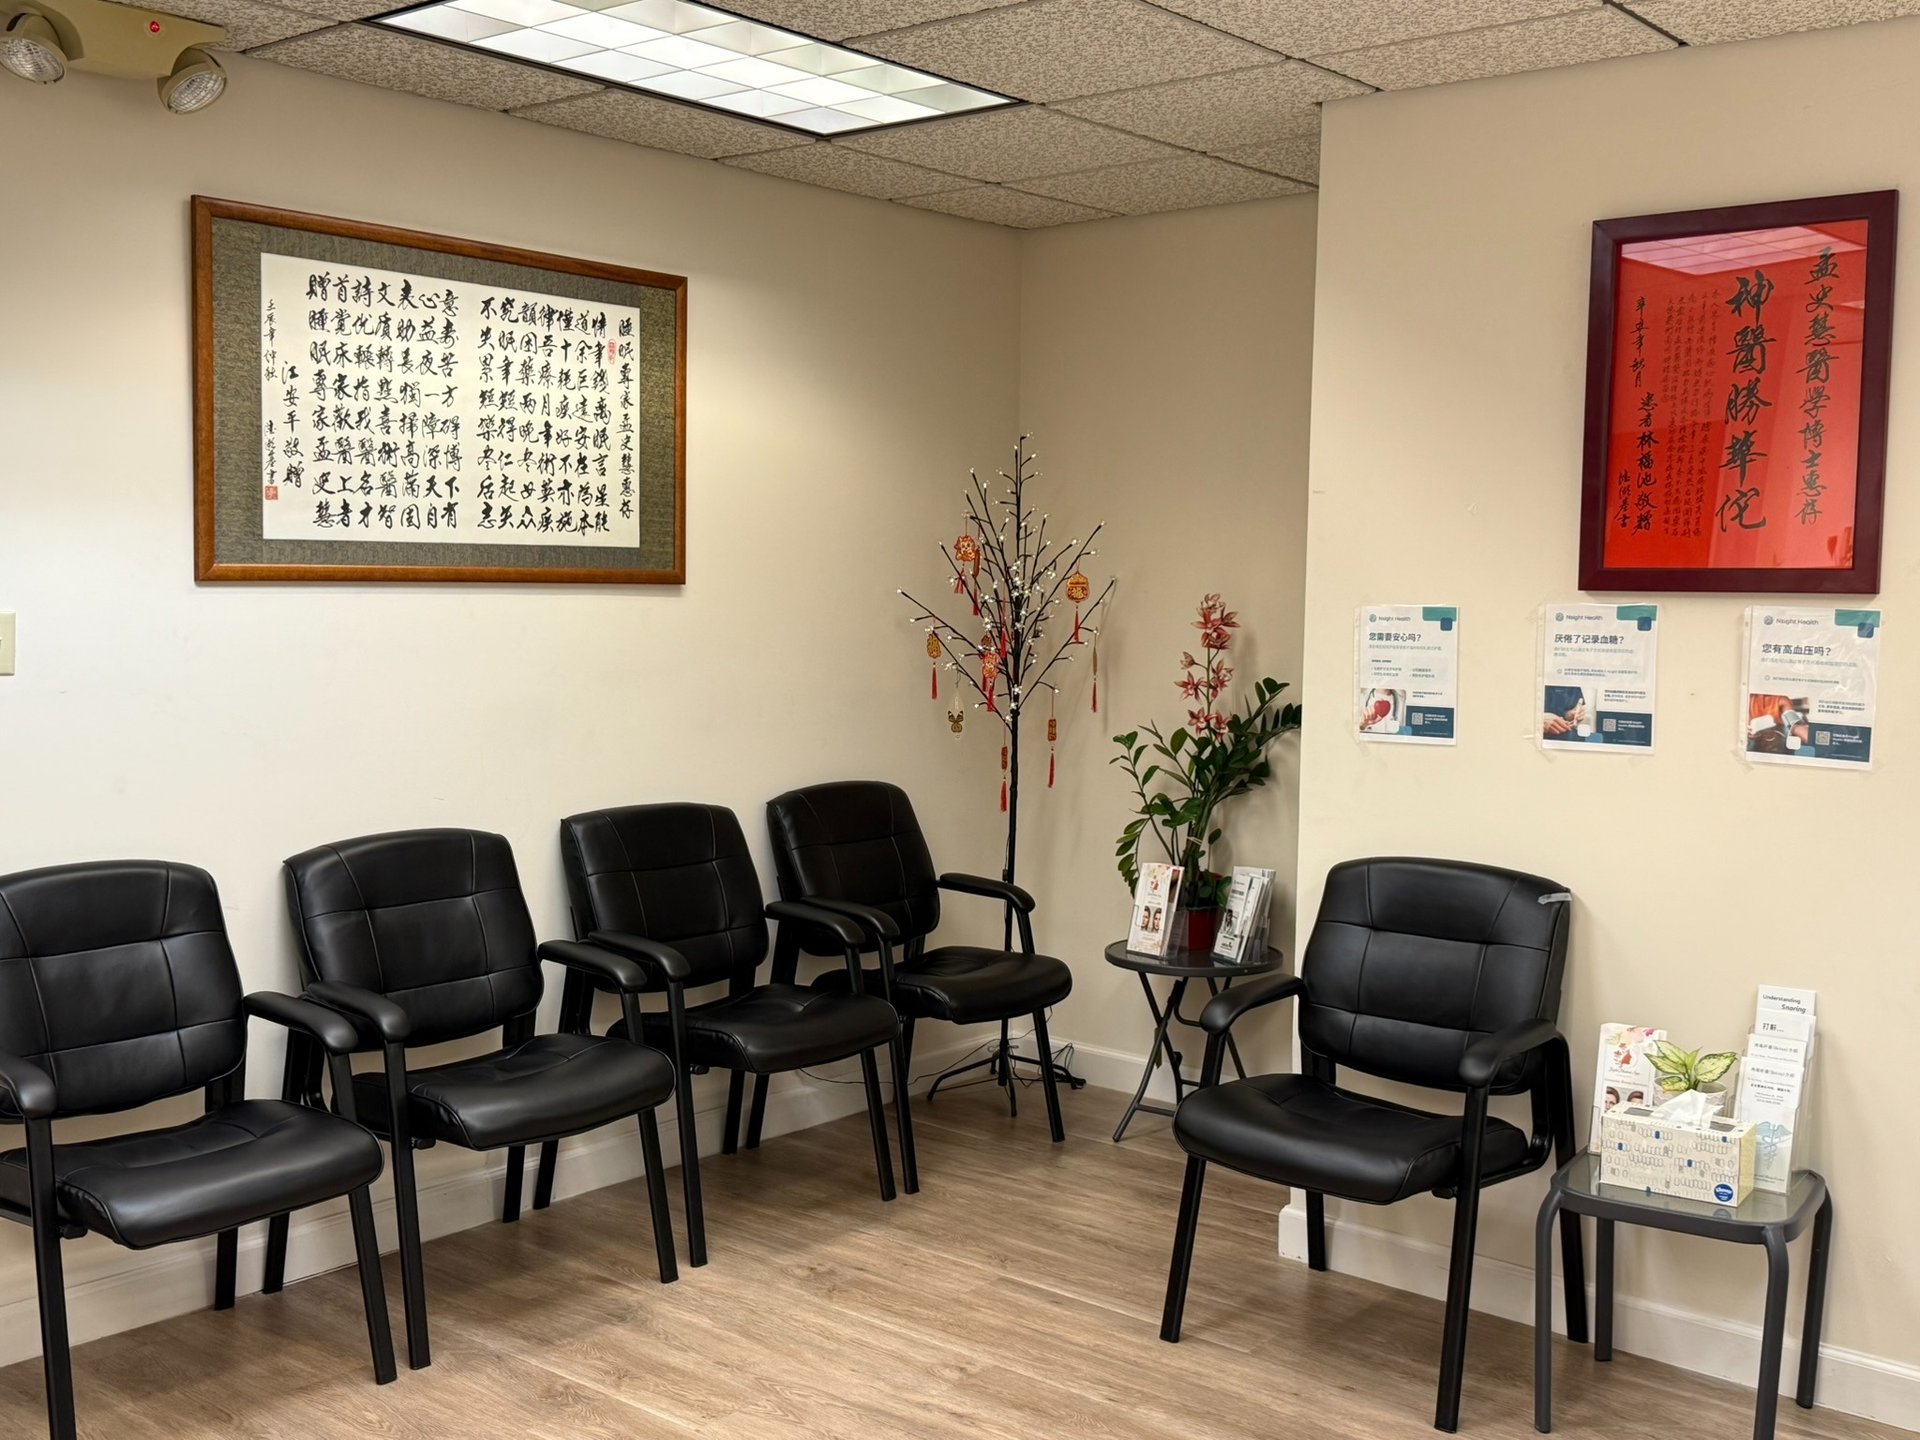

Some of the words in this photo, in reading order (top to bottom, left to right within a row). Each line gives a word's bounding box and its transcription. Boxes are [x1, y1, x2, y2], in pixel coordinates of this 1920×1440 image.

[1715, 269, 1776, 532] 神醫勝華佗
[1369, 632, 1422, 642] 您需要安心吗？
[1554, 634, 1625, 645] 厌倦了记录血糖？
[1762, 643, 1832, 657] 您有高血压吗？
[1762, 994, 1801, 1005] Understanding
[1781, 1003, 1807, 1014] Snoring
